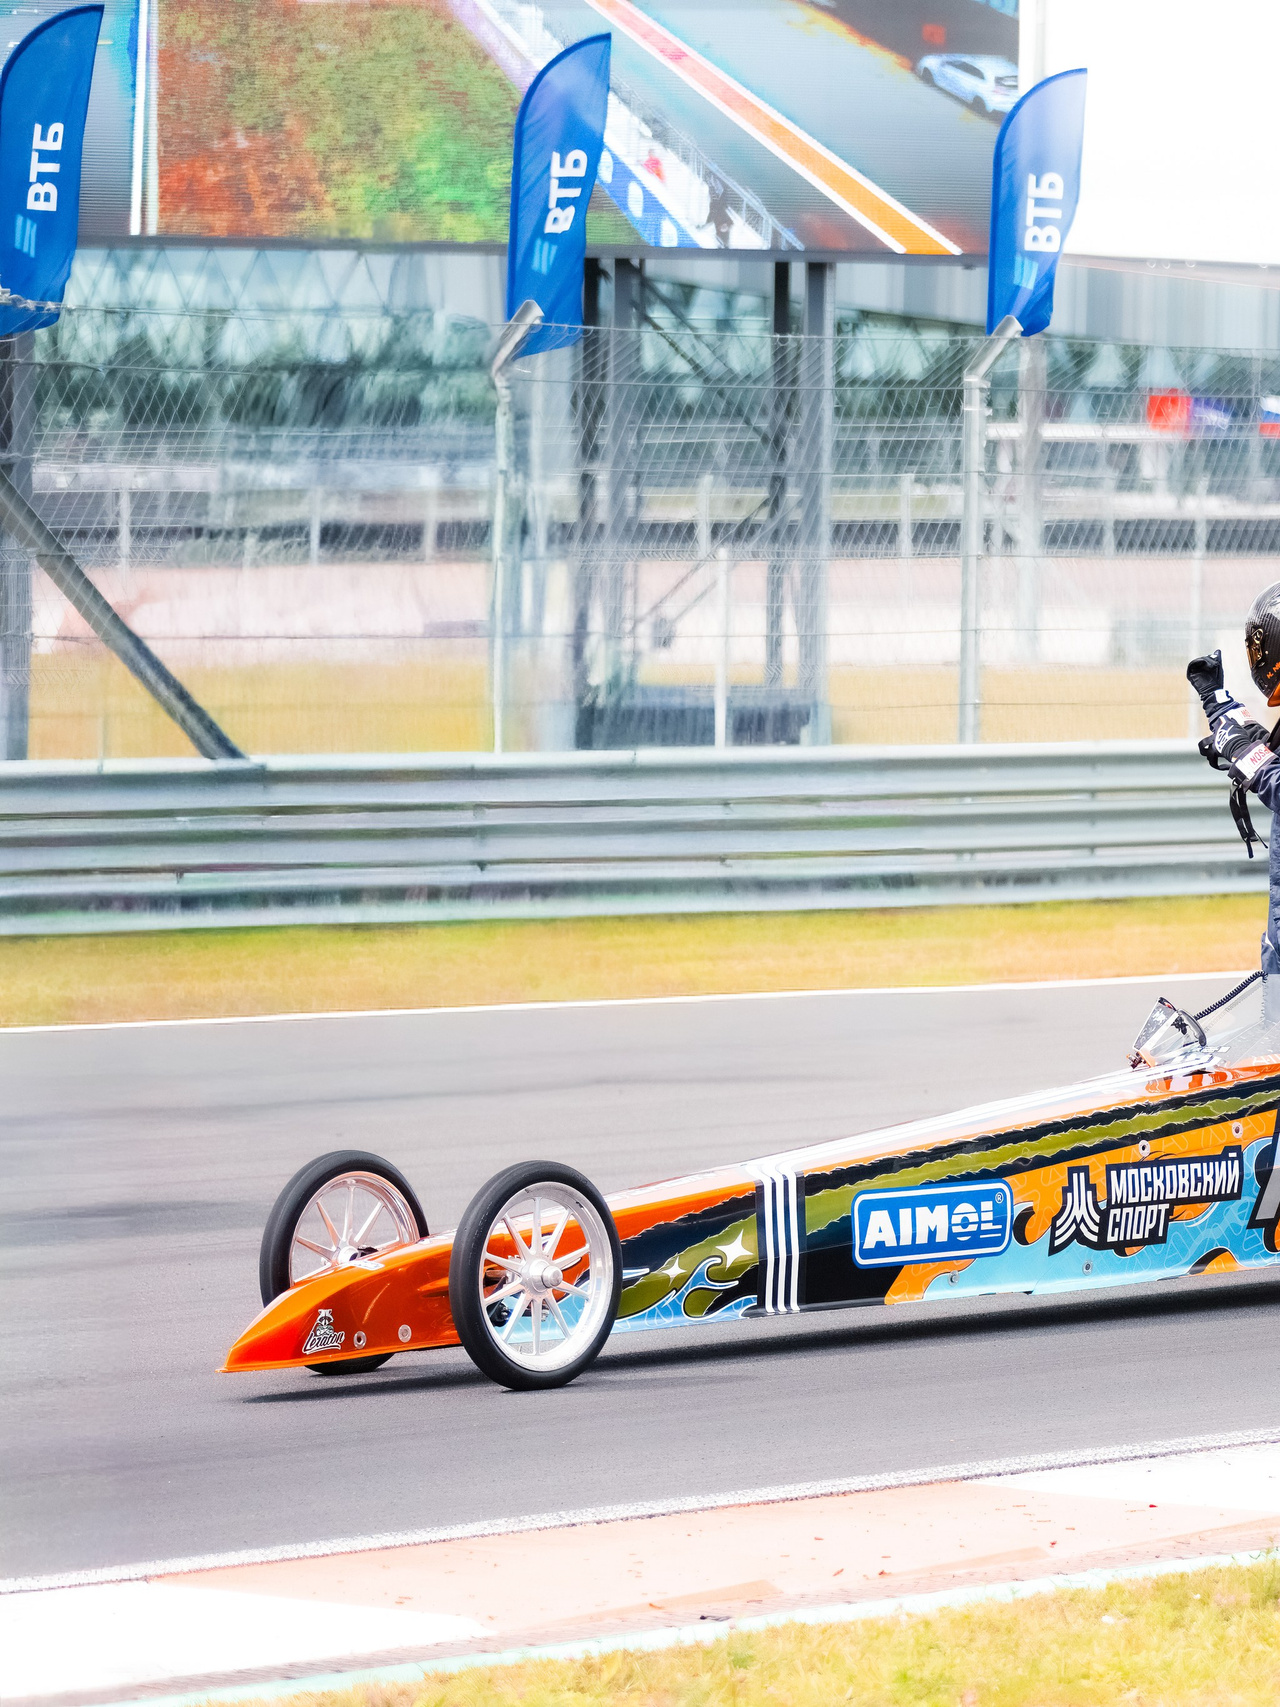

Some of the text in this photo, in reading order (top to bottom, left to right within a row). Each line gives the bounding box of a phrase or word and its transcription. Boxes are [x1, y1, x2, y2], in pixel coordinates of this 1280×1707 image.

[27, 122, 64, 211] ВТБ
[544, 149, 587, 234] ВТБ
[1024, 172, 1064, 252] ВТБ
[1110, 1152, 1240, 1205] МОСКОВСКИЙ
[1107, 1203, 1170, 1243] СПОРТ
